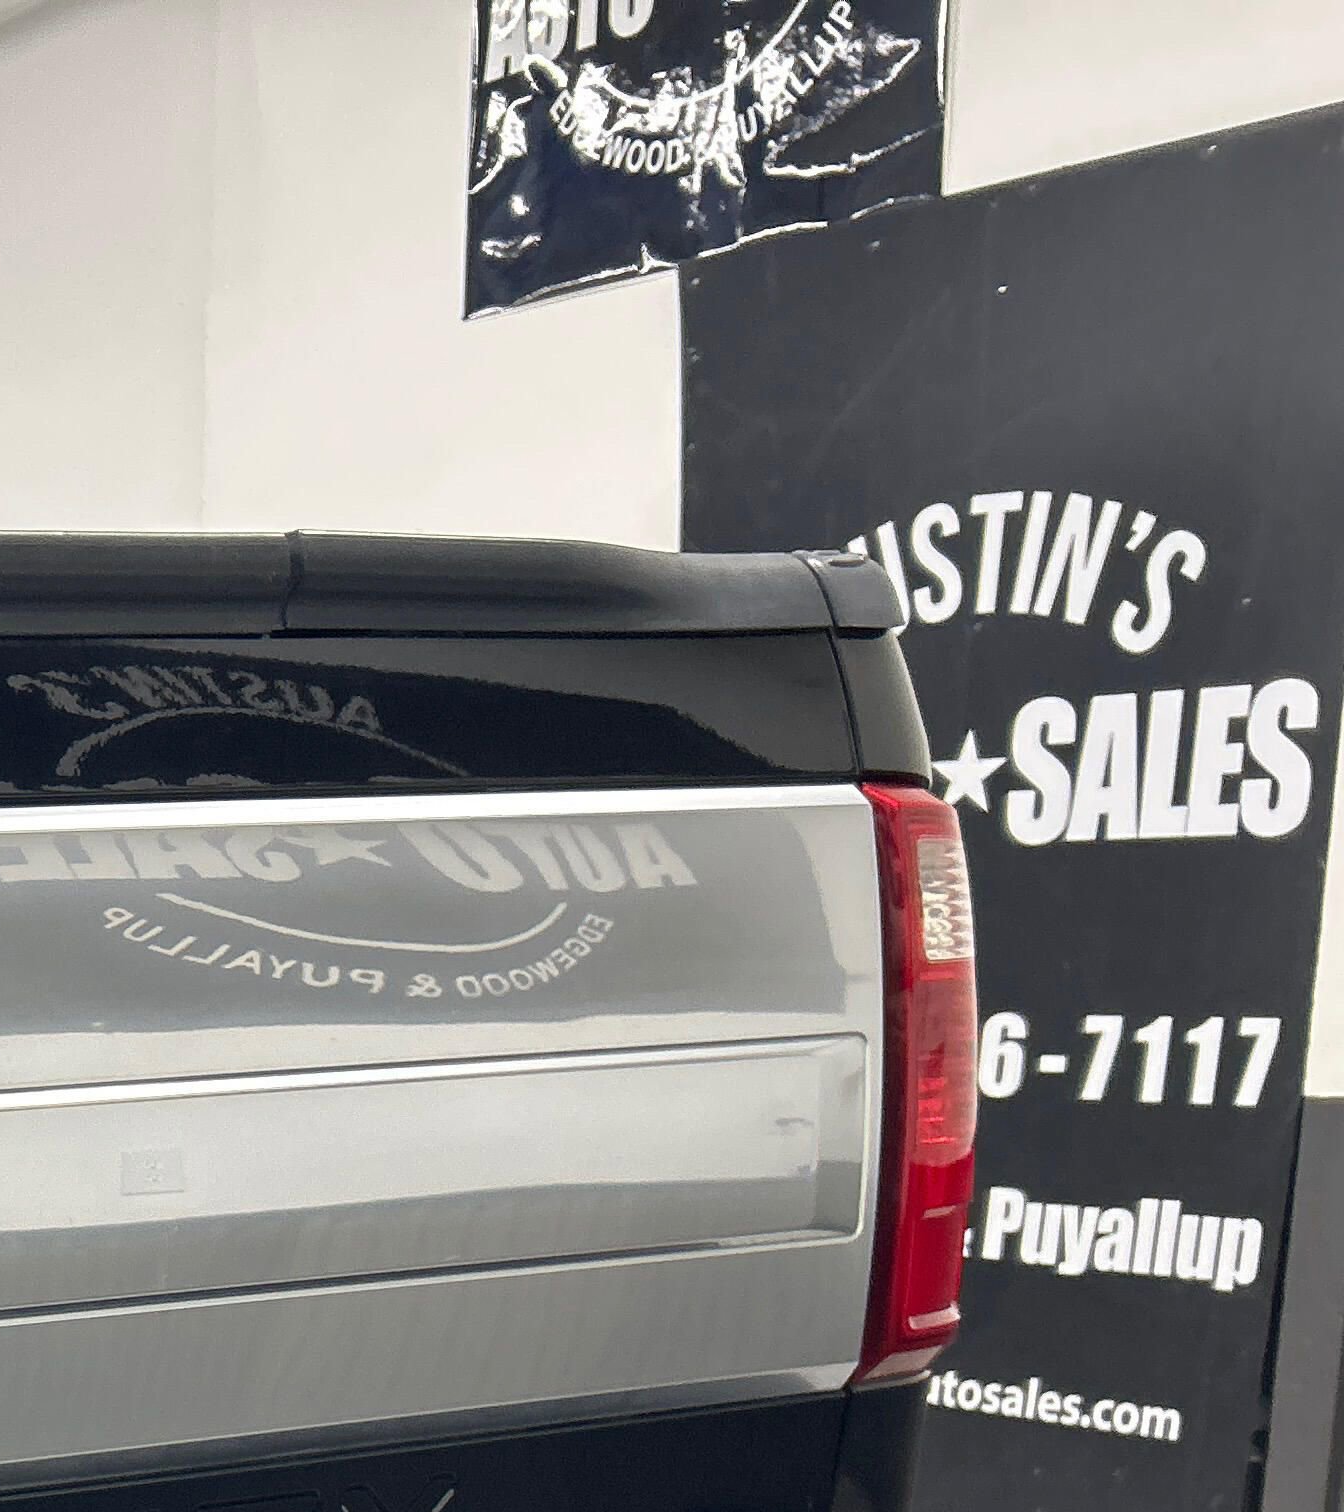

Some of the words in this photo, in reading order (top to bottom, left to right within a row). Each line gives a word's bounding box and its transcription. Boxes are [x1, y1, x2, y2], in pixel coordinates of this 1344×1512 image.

[549, 89, 692, 173] EDWOOD
[1004, 677, 1319, 847] SALES
[982, 1185, 1263, 1292] Puyallup
